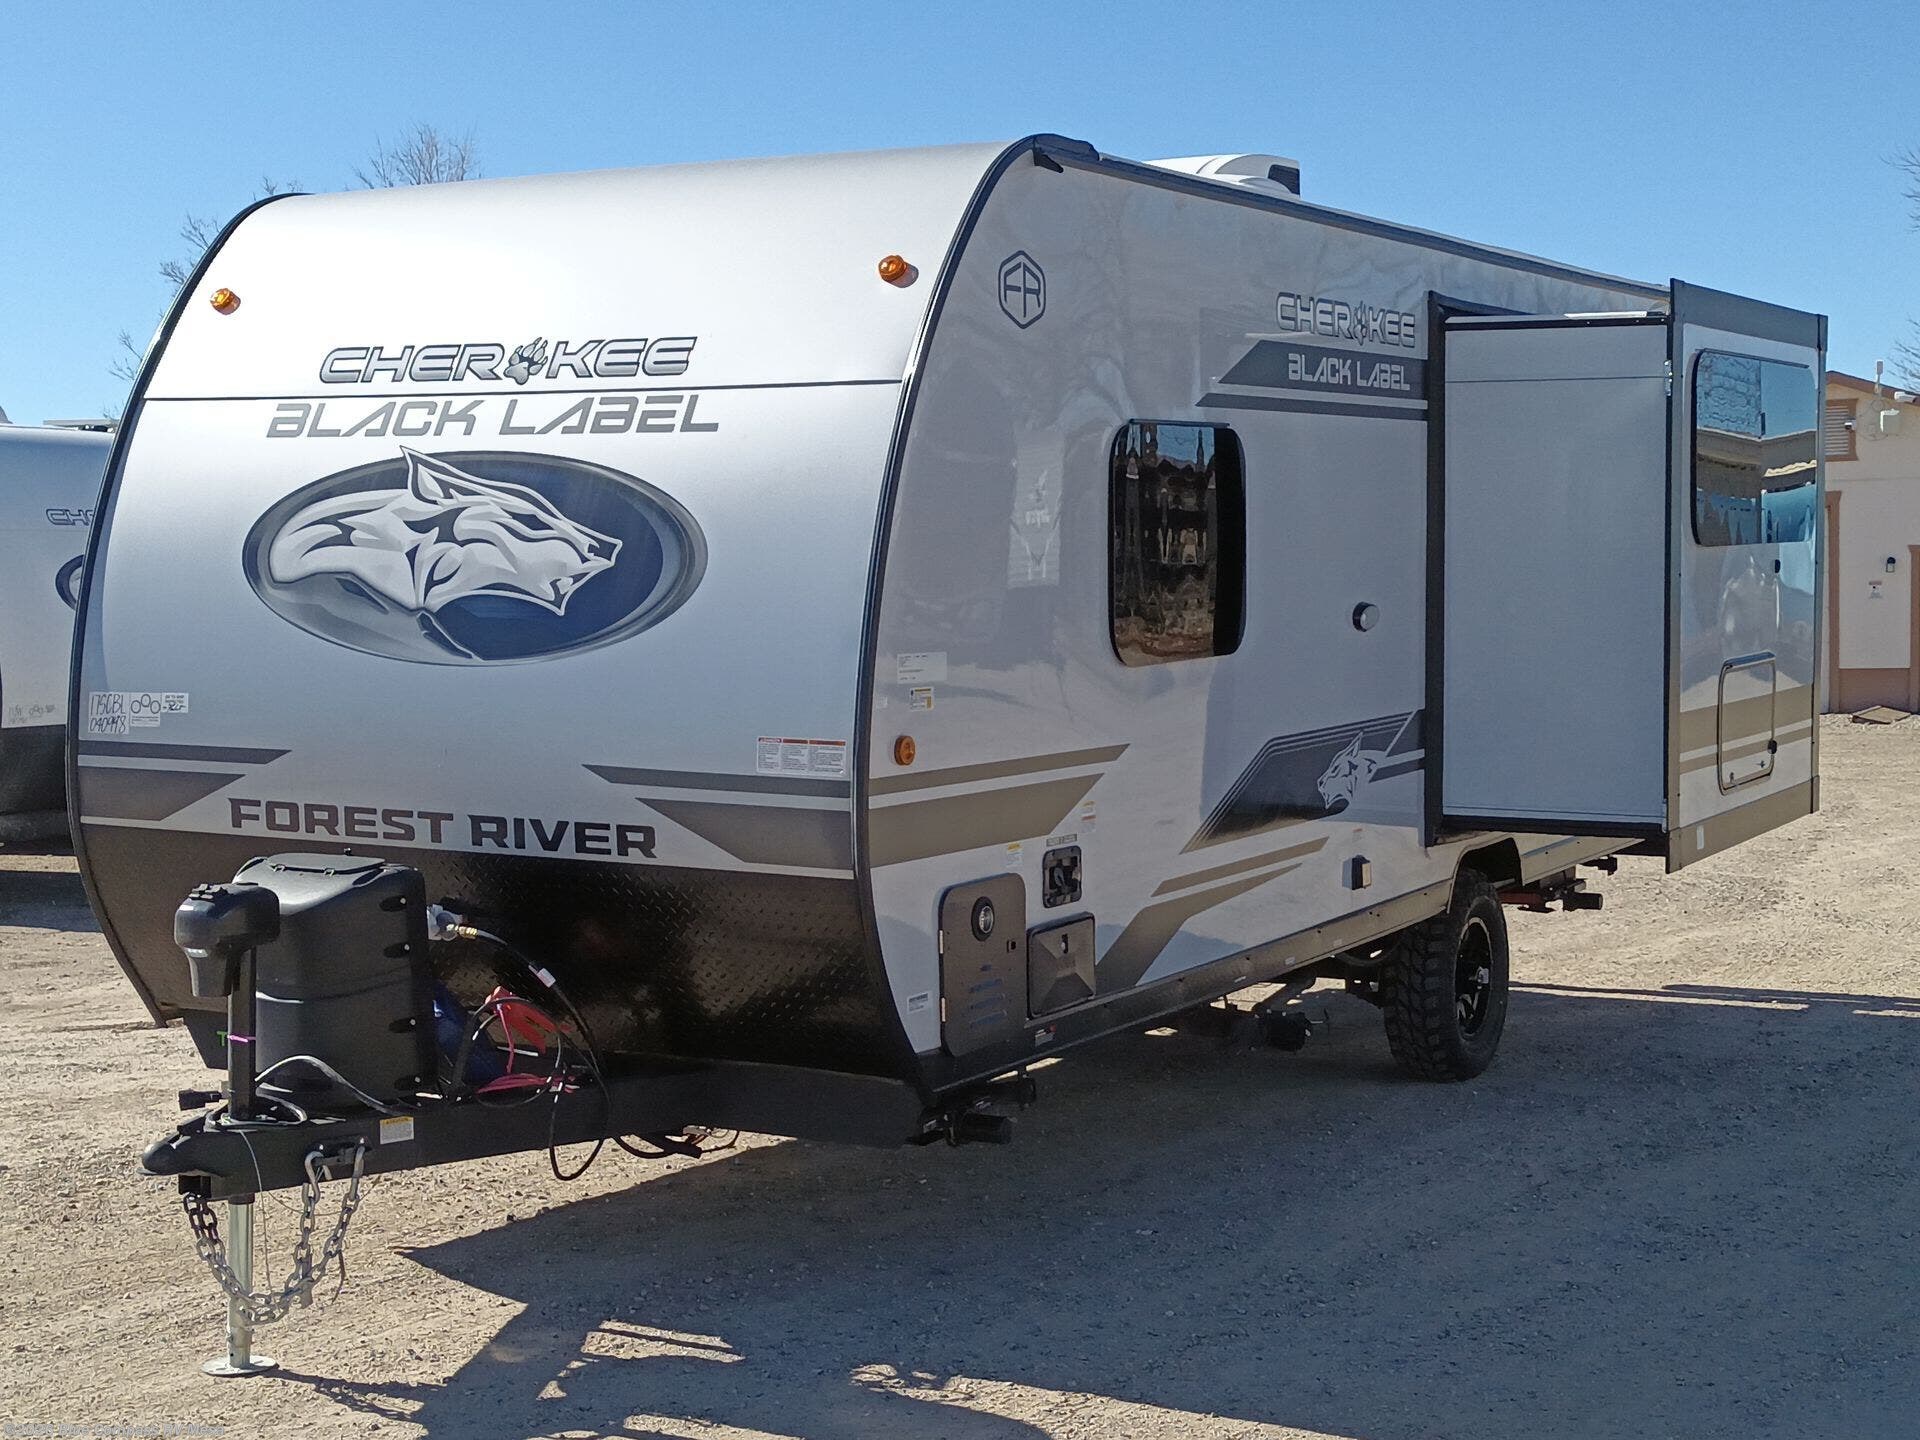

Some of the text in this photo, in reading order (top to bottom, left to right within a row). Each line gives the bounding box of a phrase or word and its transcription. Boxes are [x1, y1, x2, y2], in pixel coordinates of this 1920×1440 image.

[1288, 353, 1411, 390] BLACK LABEL
[266, 395, 719, 438] BLACK LABEL
[227, 798, 658, 859] FOREST RIVER
